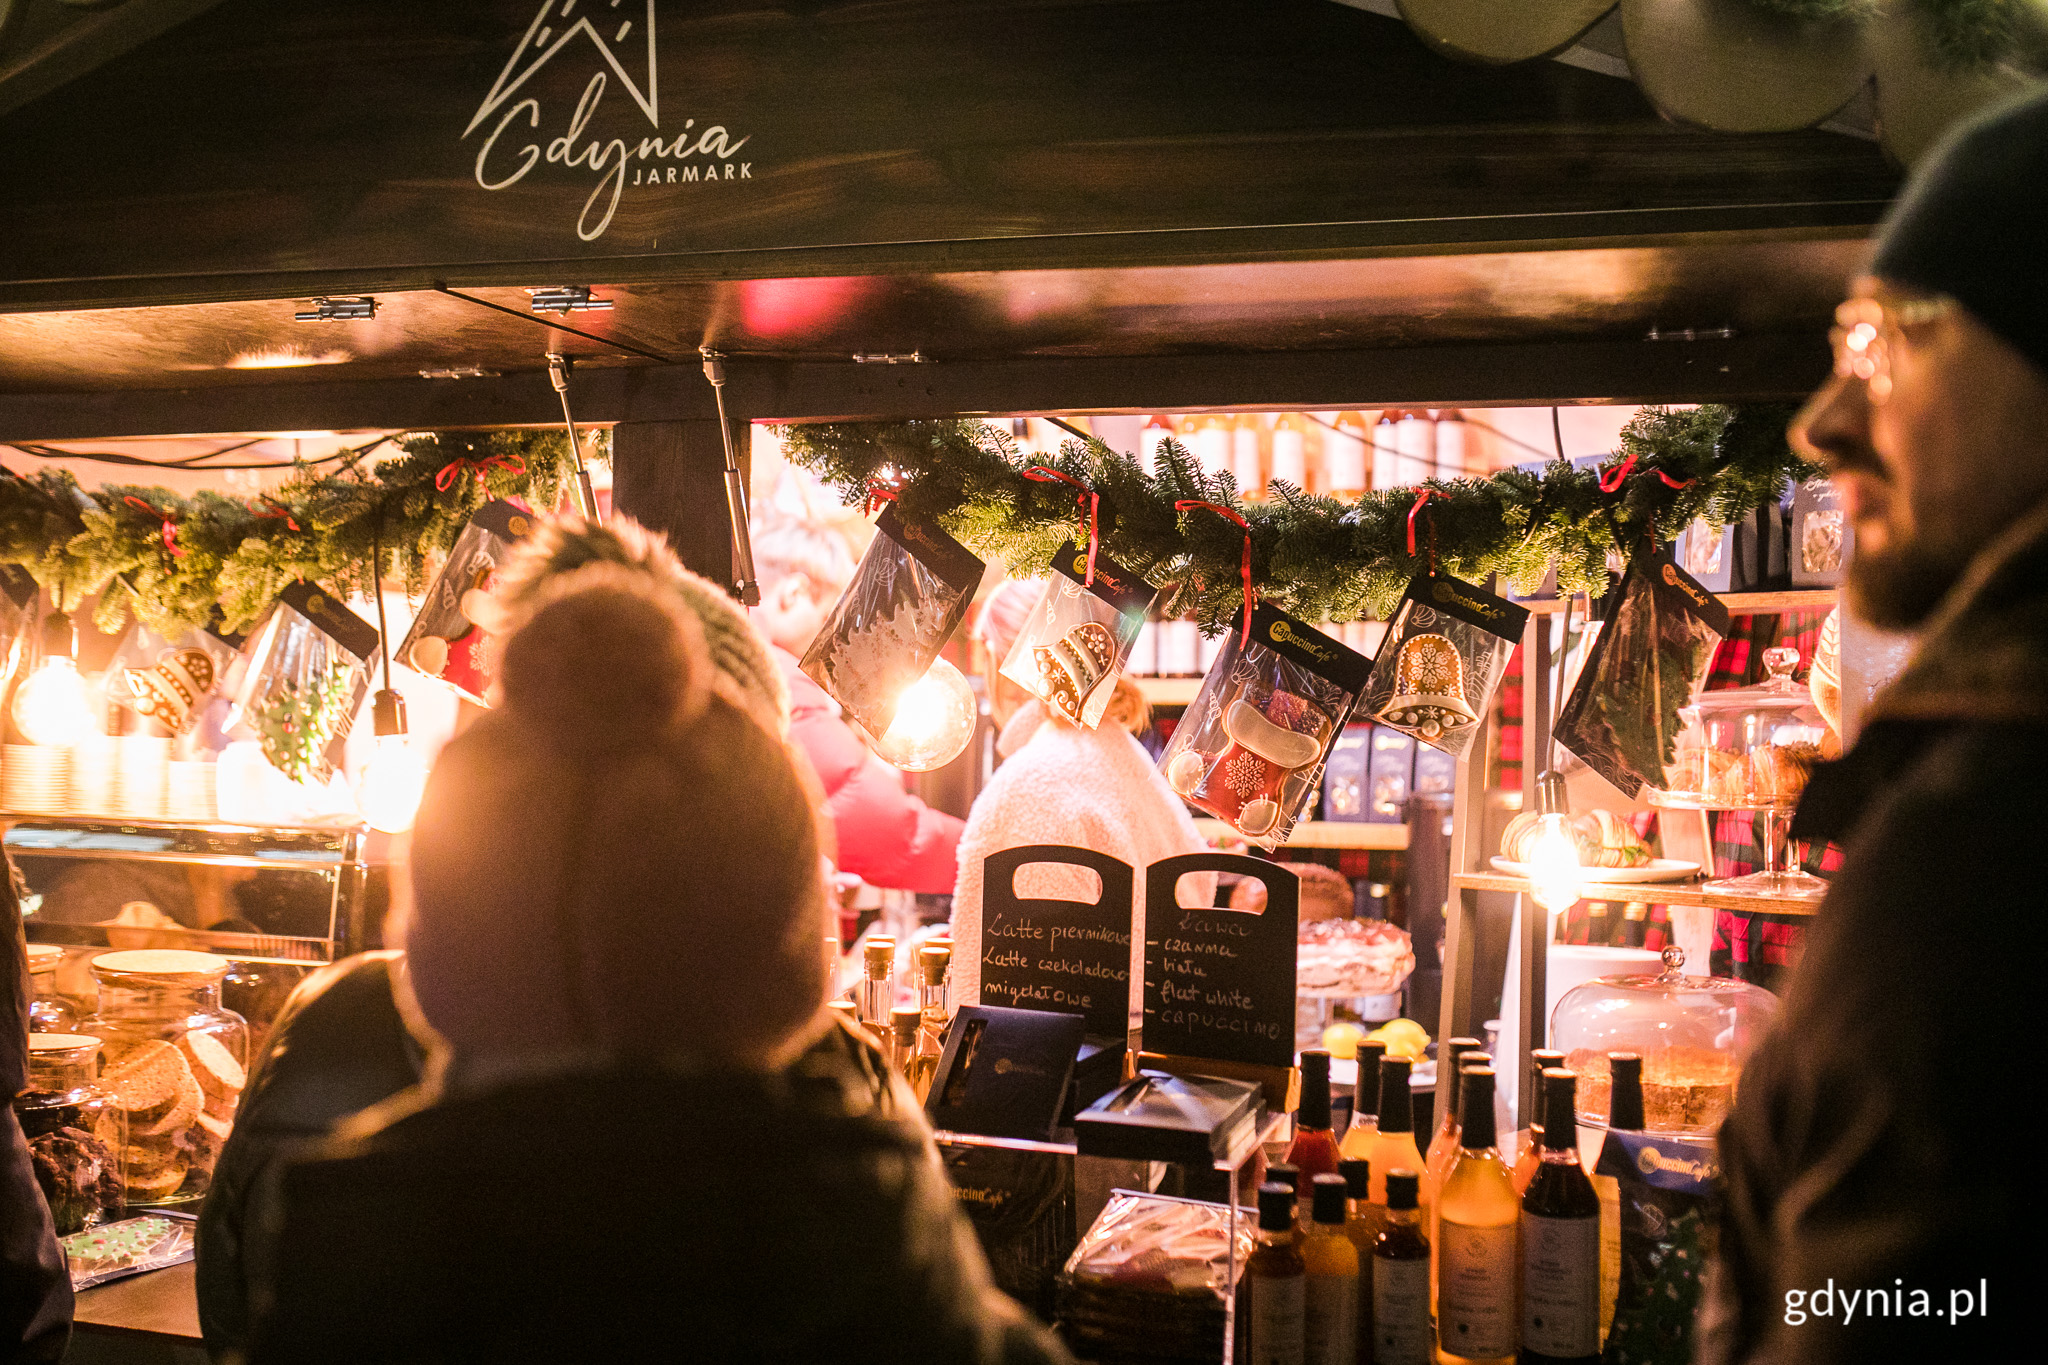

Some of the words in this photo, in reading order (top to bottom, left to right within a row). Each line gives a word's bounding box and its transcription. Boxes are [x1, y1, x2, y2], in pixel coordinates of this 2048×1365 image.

[475, 71, 752, 241] Gdynia
[633, 163, 753, 186] JARMARK
[987, 912, 1044, 940] Latte
[982, 945, 1029, 968] Latte
[1160, 979, 1200, 1005] flat
[1205, 988, 1255, 1010] white
